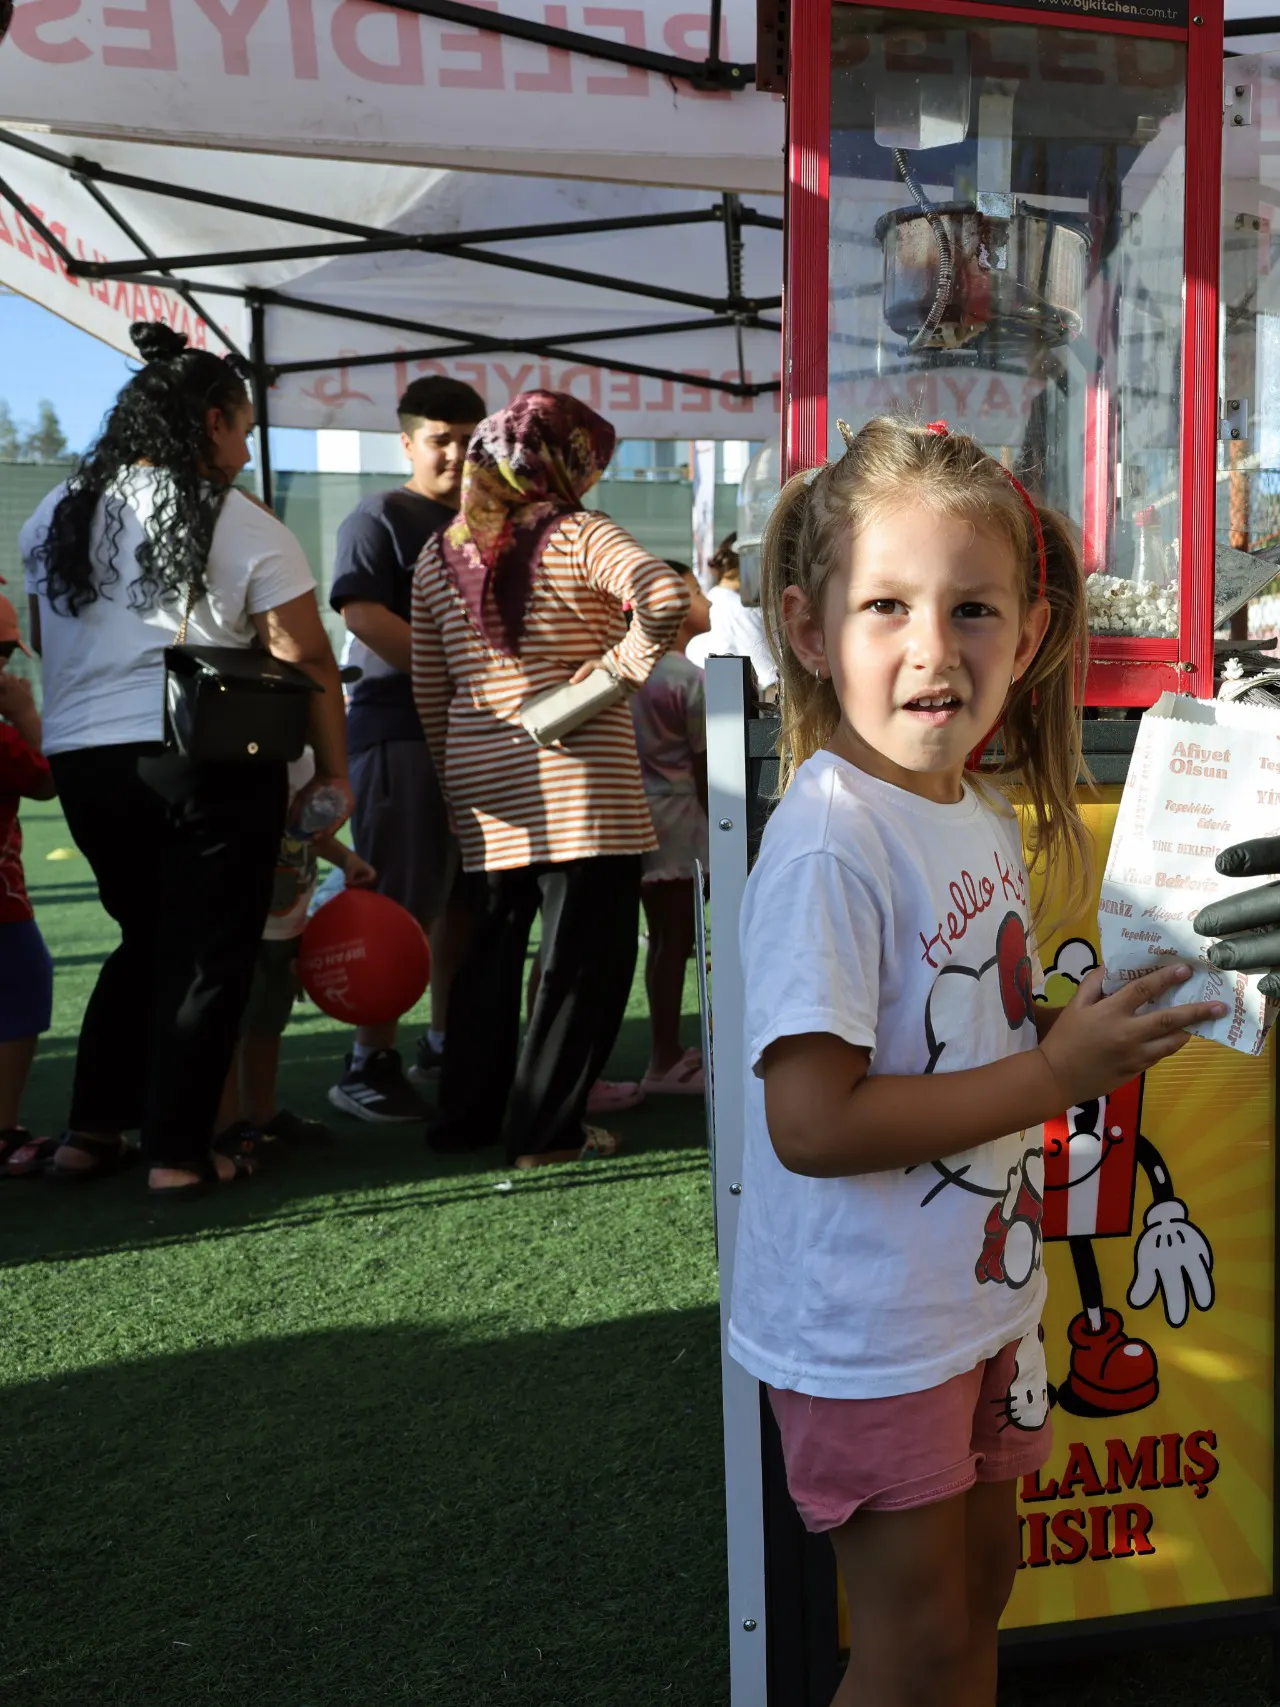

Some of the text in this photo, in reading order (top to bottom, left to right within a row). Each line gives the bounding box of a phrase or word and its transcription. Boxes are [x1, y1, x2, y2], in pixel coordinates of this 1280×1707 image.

[1172, 741, 1231, 763] Afiyet
[1169, 758, 1228, 780] Olsun
[1164, 799, 1215, 816] Teşekkür
[1197, 817, 1232, 832] Ederiz
[920, 869, 995, 969] Hello
[1121, 927, 1162, 943] Teşekkür
[1018, 1503, 1156, 1570] ISIR
